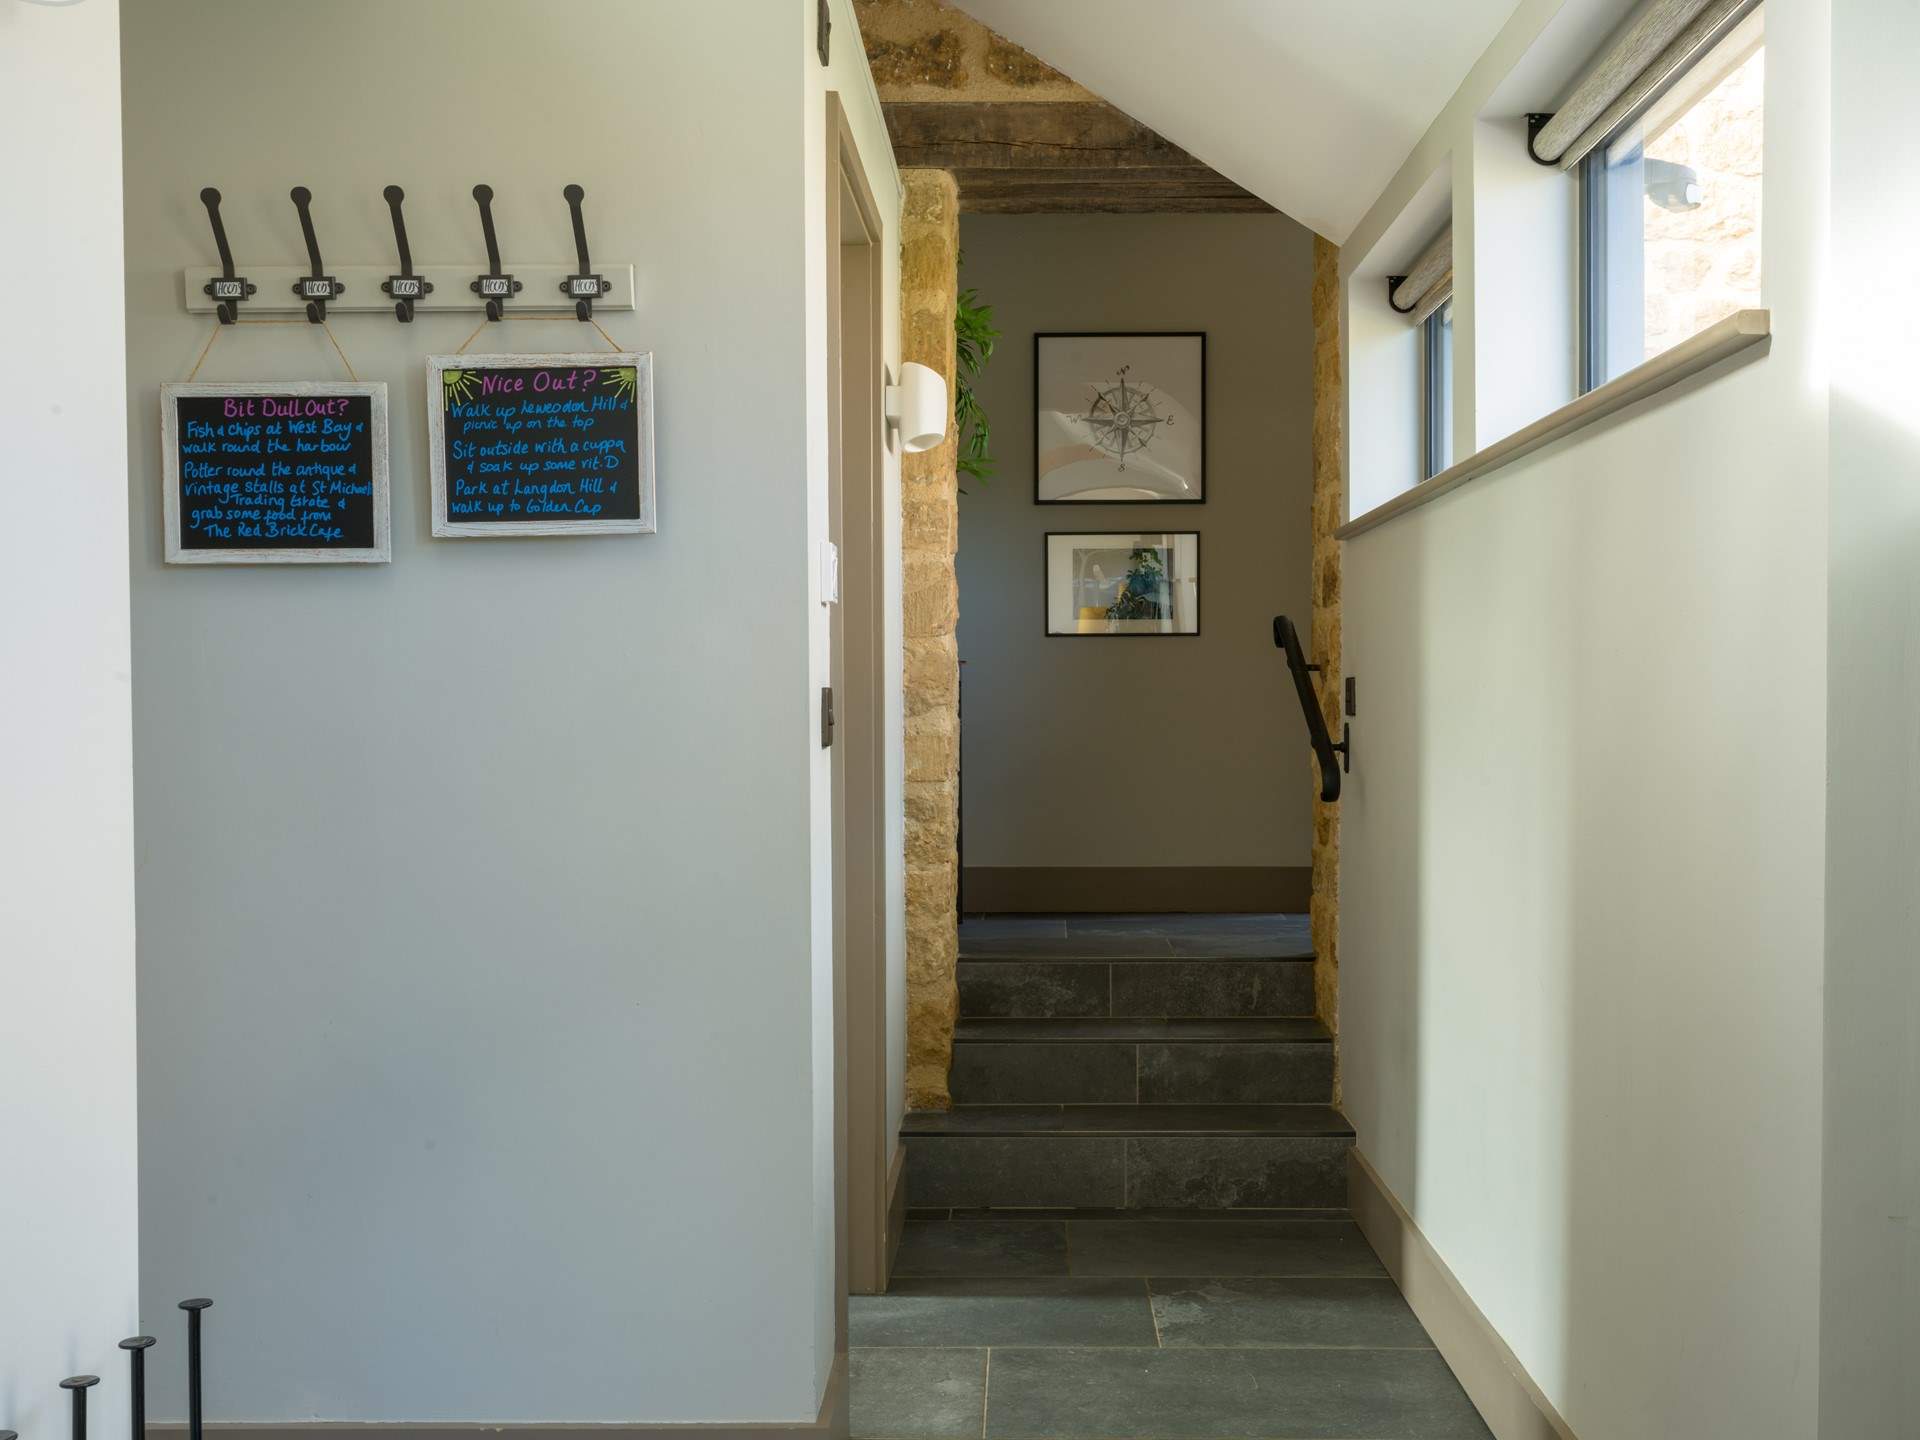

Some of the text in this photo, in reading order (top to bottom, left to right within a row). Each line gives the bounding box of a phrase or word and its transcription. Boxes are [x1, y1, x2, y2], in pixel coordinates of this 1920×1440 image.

[1116, 365, 1130, 375] N
[482, 375, 524, 395] Nice
[224, 399, 349, 417] Bit Dull Out?
[451, 402, 490, 418] Walk
[496, 407, 515, 424] up
[592, 396, 616, 410] Hill
[464, 417, 594, 433] picnic up on the top
[1066, 415, 1081, 424] W
[1166, 415, 1175, 425] E
[187, 421, 214, 438] Fish
[266, 425, 282, 435] at
[288, 421, 317, 434] West
[322, 419, 352, 441] Bay
[183, 443, 216, 453] walk
[222, 442, 260, 453] round
[268, 441, 289, 452] the
[453, 438, 626, 459] Sit outside with a cuppa
[184, 461, 223, 479] Potter
[227, 462, 266, 476] round
[272, 461, 291, 475] the
[296, 462, 345, 480] antique
[480, 461, 512, 472] soak
[520, 462, 539, 475] up
[543, 461, 575, 471] some
[605, 456, 620, 468] D
[1118, 463, 1127, 472] S
[289, 481, 305, 494] at
[312, 480, 325, 495] St
[456, 479, 488, 495] Park
[493, 480, 509, 494] at
[514, 479, 575, 503] Langdon
[580, 480, 603, 493] Hill
[230, 494, 284, 512] Trading
[451, 497, 601, 515] walk up to Golden Cap
[190, 507, 331, 529] grab some food from
[204, 524, 232, 538] The
[238, 523, 262, 537] Red
[265, 522, 307, 537] Brick
